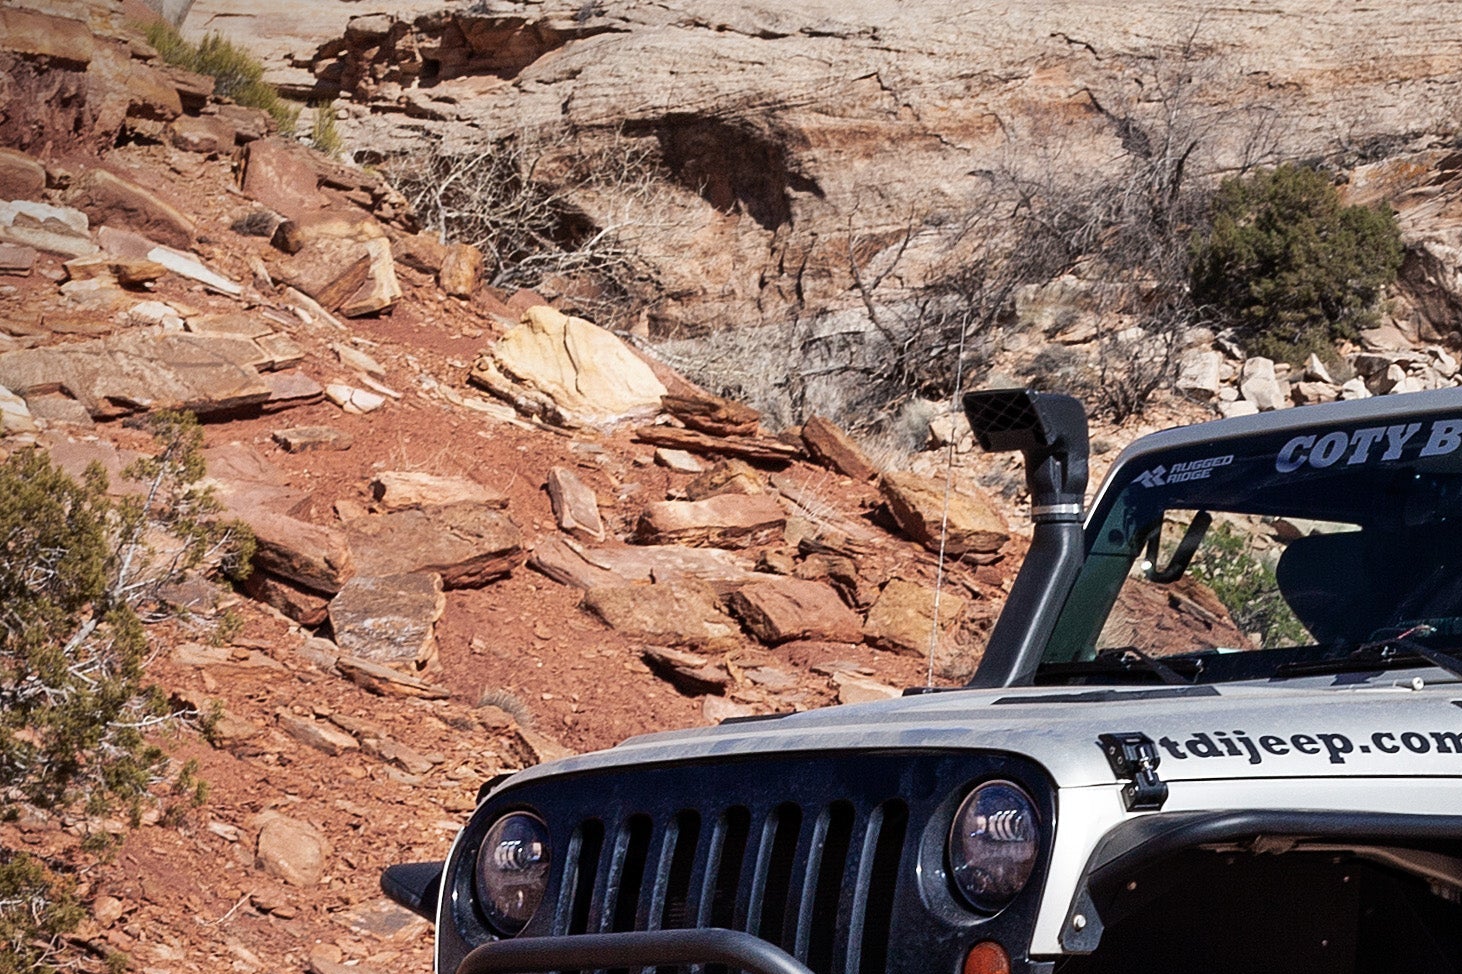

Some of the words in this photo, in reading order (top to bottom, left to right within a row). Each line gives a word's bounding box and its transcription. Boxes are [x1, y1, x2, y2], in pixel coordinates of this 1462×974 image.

[1275, 422, 1422, 473] COTY
[1170, 454, 1234, 474] RUGGED
[1166, 467, 1214, 484] RIDGE
